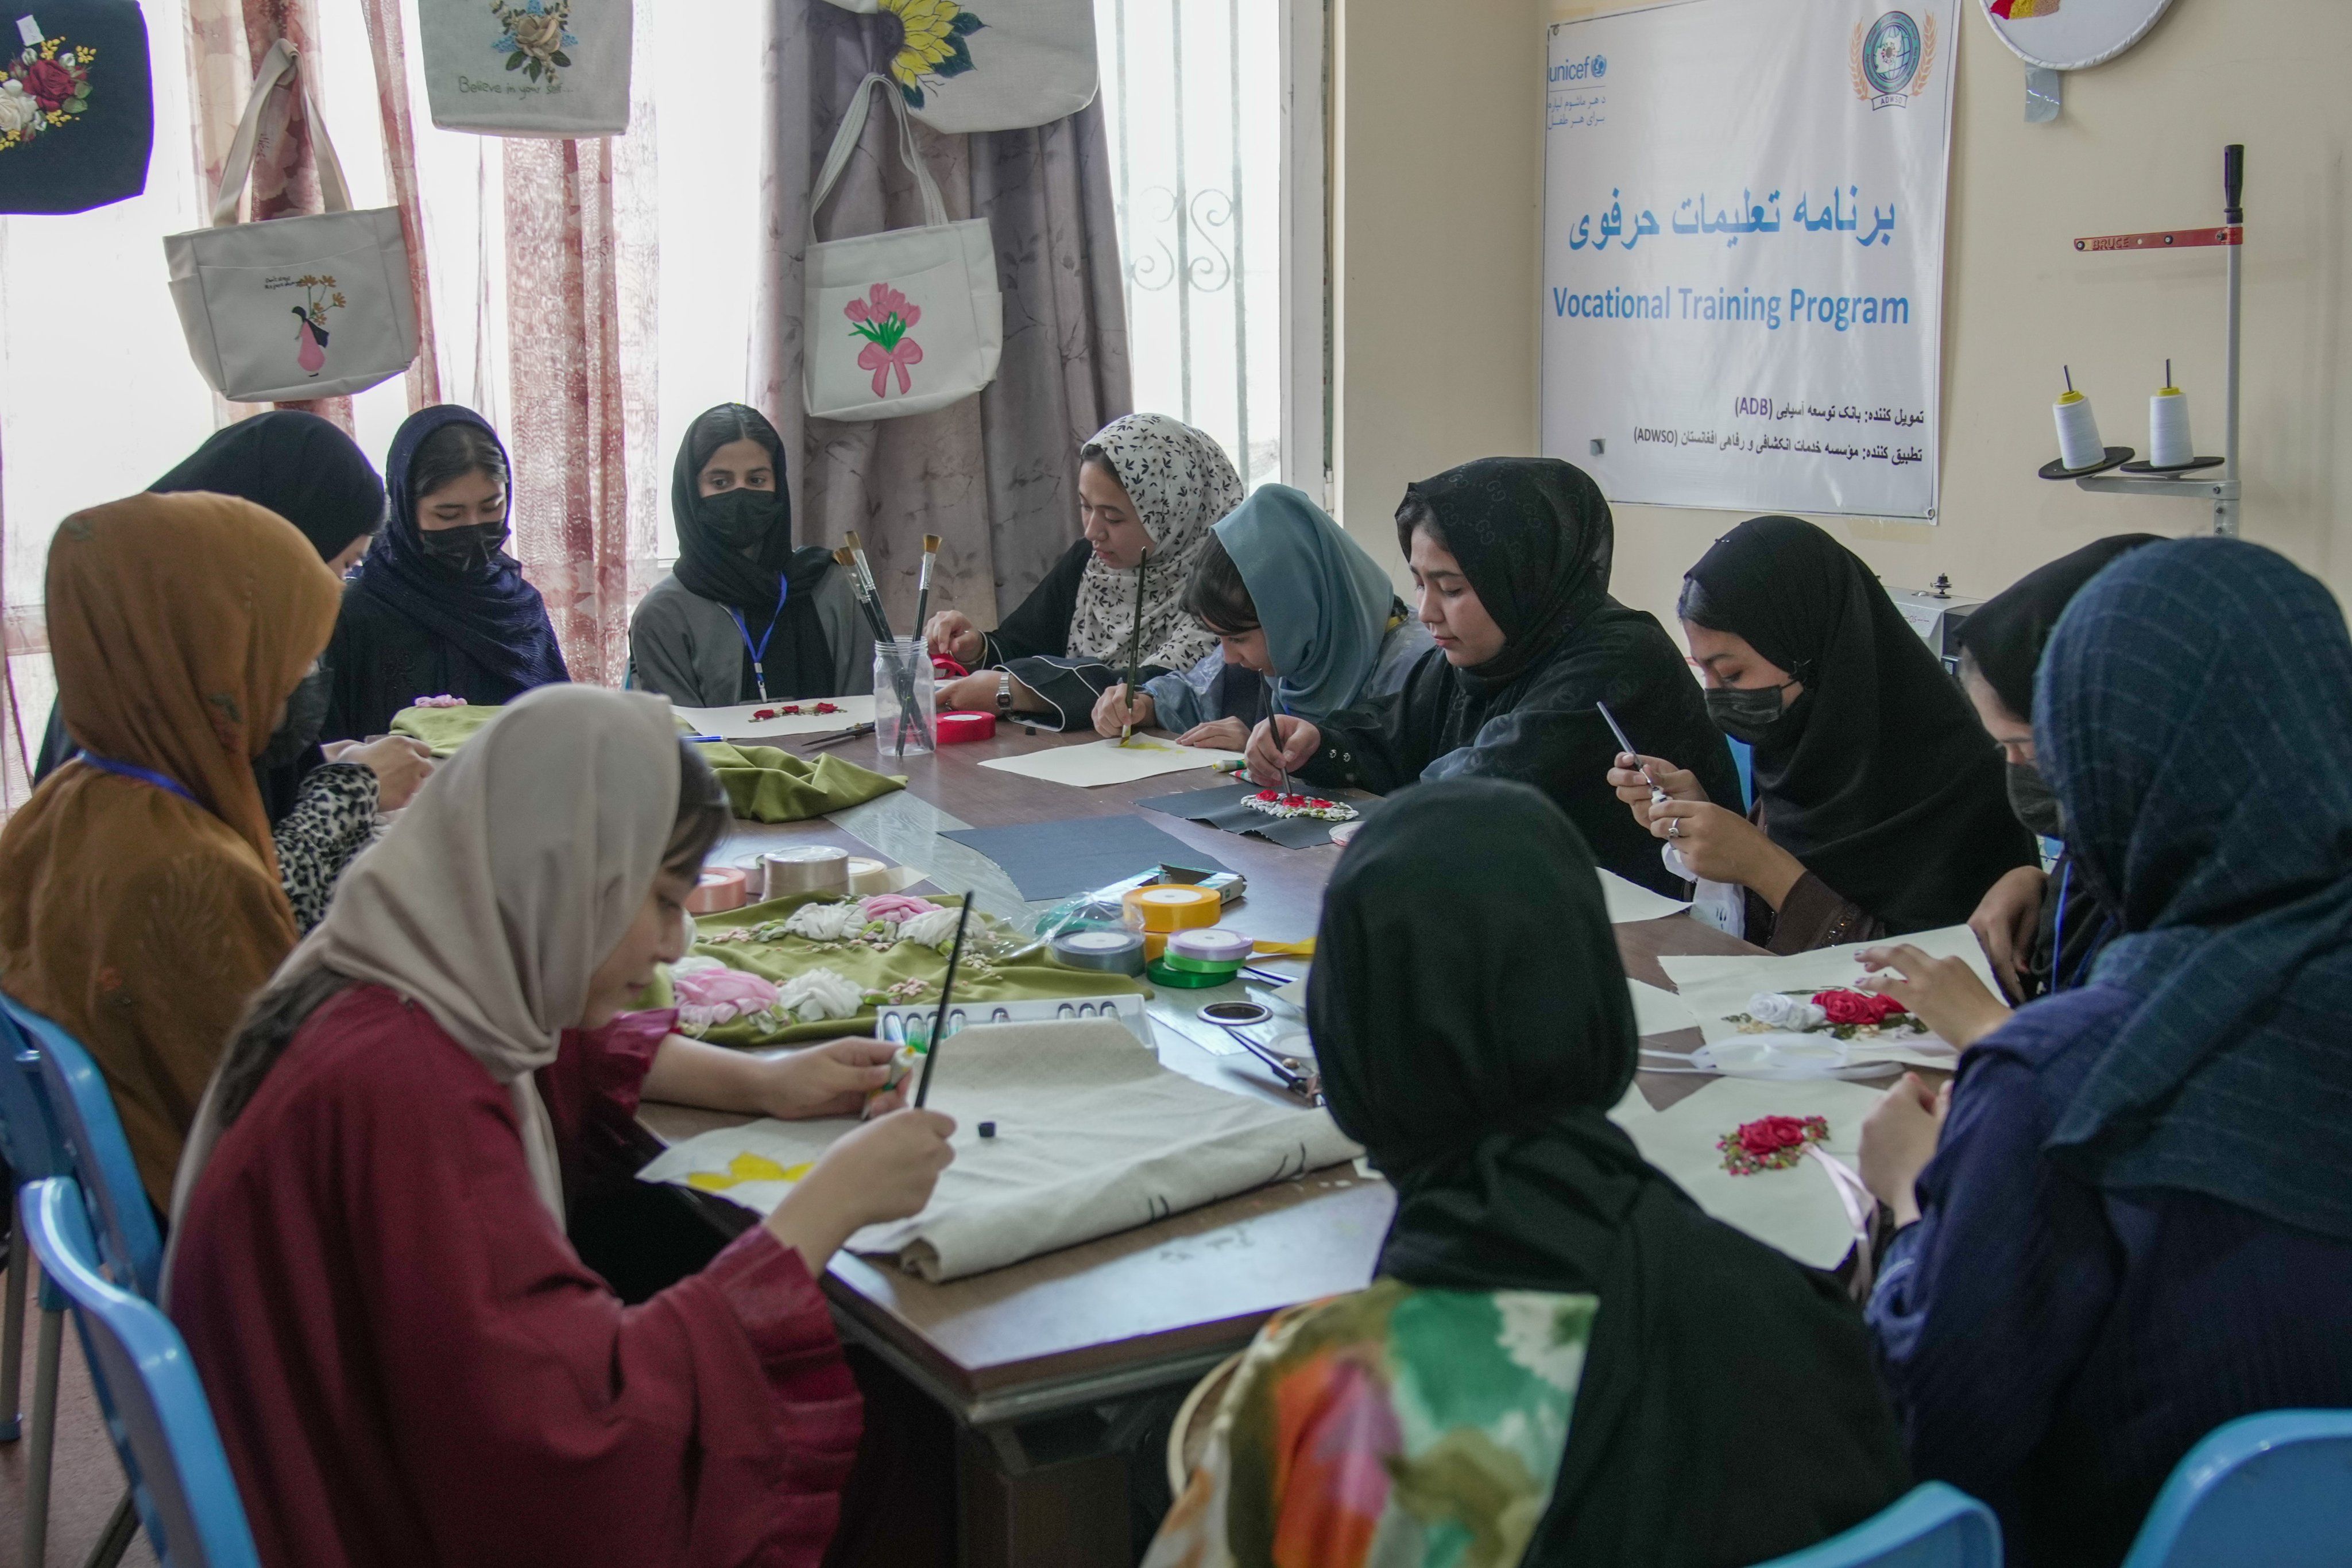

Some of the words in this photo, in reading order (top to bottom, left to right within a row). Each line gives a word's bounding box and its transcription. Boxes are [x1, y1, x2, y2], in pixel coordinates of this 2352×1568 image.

[1549, 56, 1590, 82] unicef
[1569, 188, 1660, 250] حرفوی
[1672, 188, 1781, 248] تعلیمات
[1793, 185, 1895, 247] برنامه
[2093, 238, 2130, 250] BRUCE
[1553, 286, 1670, 319] Vocational
[1678, 287, 1781, 330] Training
[1790, 288, 1909, 332] Program
[1735, 397, 1773, 420] (ADB)
[1808, 405, 1836, 421] توسعه
[1839, 406, 1861, 423] بانک
[1894, 409, 1924, 427] تمویل
[1634, 426, 1678, 447] (ADWSO)
[1681, 430, 1716, 446] افغانستان
[1720, 432, 1744, 451] رفاهی
[1747, 440, 1753, 451] و
[1756, 434, 1791, 454] انکشافی
[1794, 439, 1821, 454] خدمات
[1891, 446, 1922, 466] تطبیق
